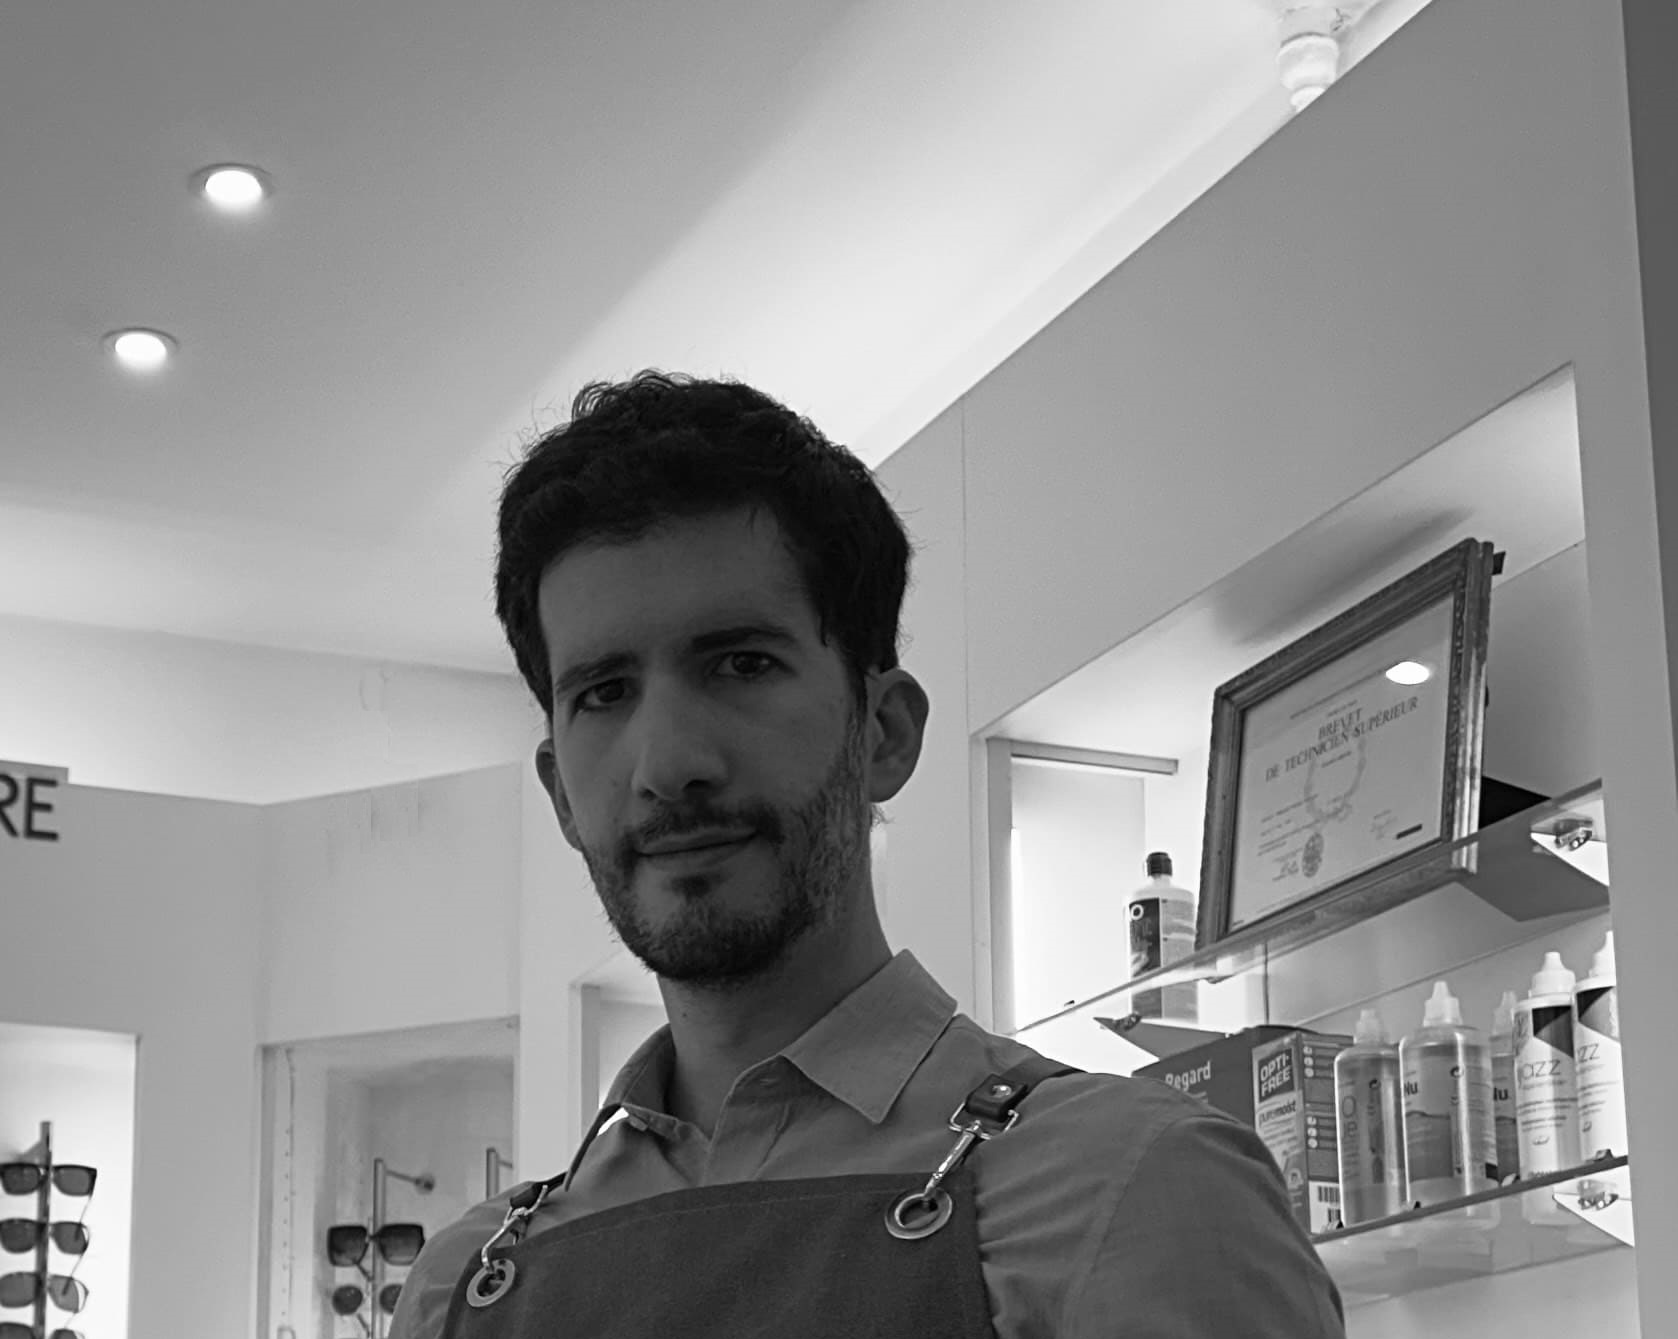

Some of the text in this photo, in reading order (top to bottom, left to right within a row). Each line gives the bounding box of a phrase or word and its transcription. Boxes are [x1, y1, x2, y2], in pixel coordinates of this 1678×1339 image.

[1317, 707, 1363, 740] BREVET
[1265, 763, 1280, 782] DE
[1284, 731, 1349, 772] TECHNICIEN
[0, 773, 59, 841] RE
[1260, 1051, 1290, 1082] OPTI-
[1260, 1064, 1291, 1098] FREE
